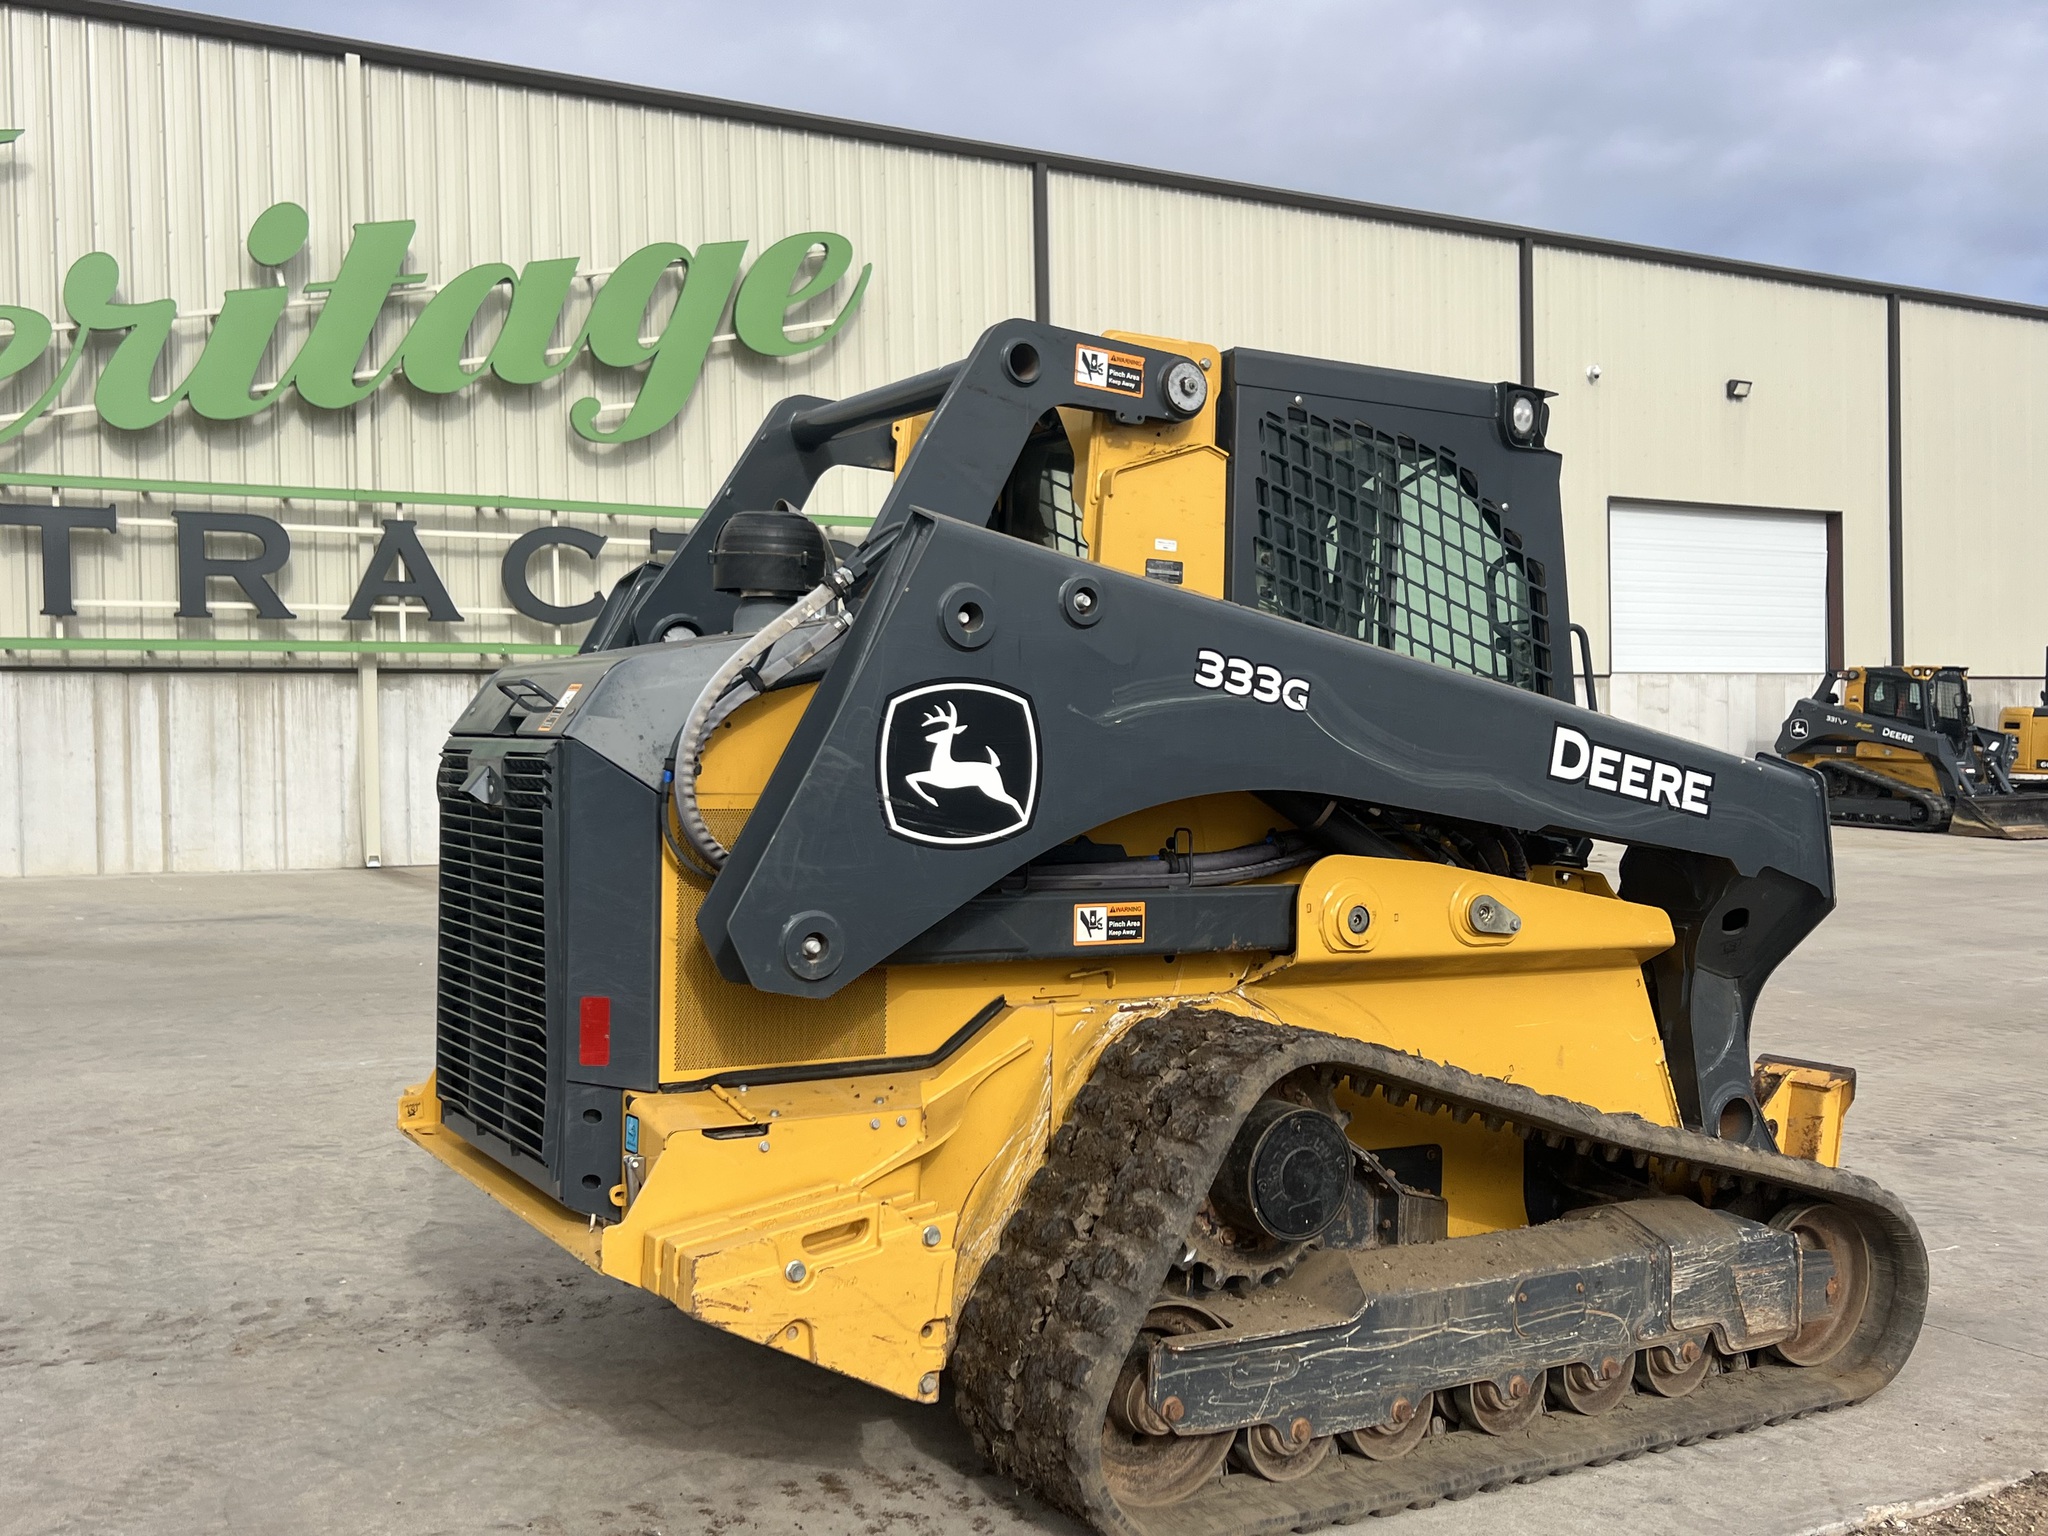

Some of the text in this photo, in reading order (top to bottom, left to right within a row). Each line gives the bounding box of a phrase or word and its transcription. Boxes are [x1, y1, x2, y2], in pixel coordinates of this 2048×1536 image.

[1109, 368, 1140, 382] Pinch Area
[1108, 378, 1135, 389] Keep Away
[1195, 649, 1311, 712] 333G
[1881, 726, 1915, 744] DEERE
[1549, 725, 1714, 816] DEERE
[1109, 920, 1126, 928] Pinch
